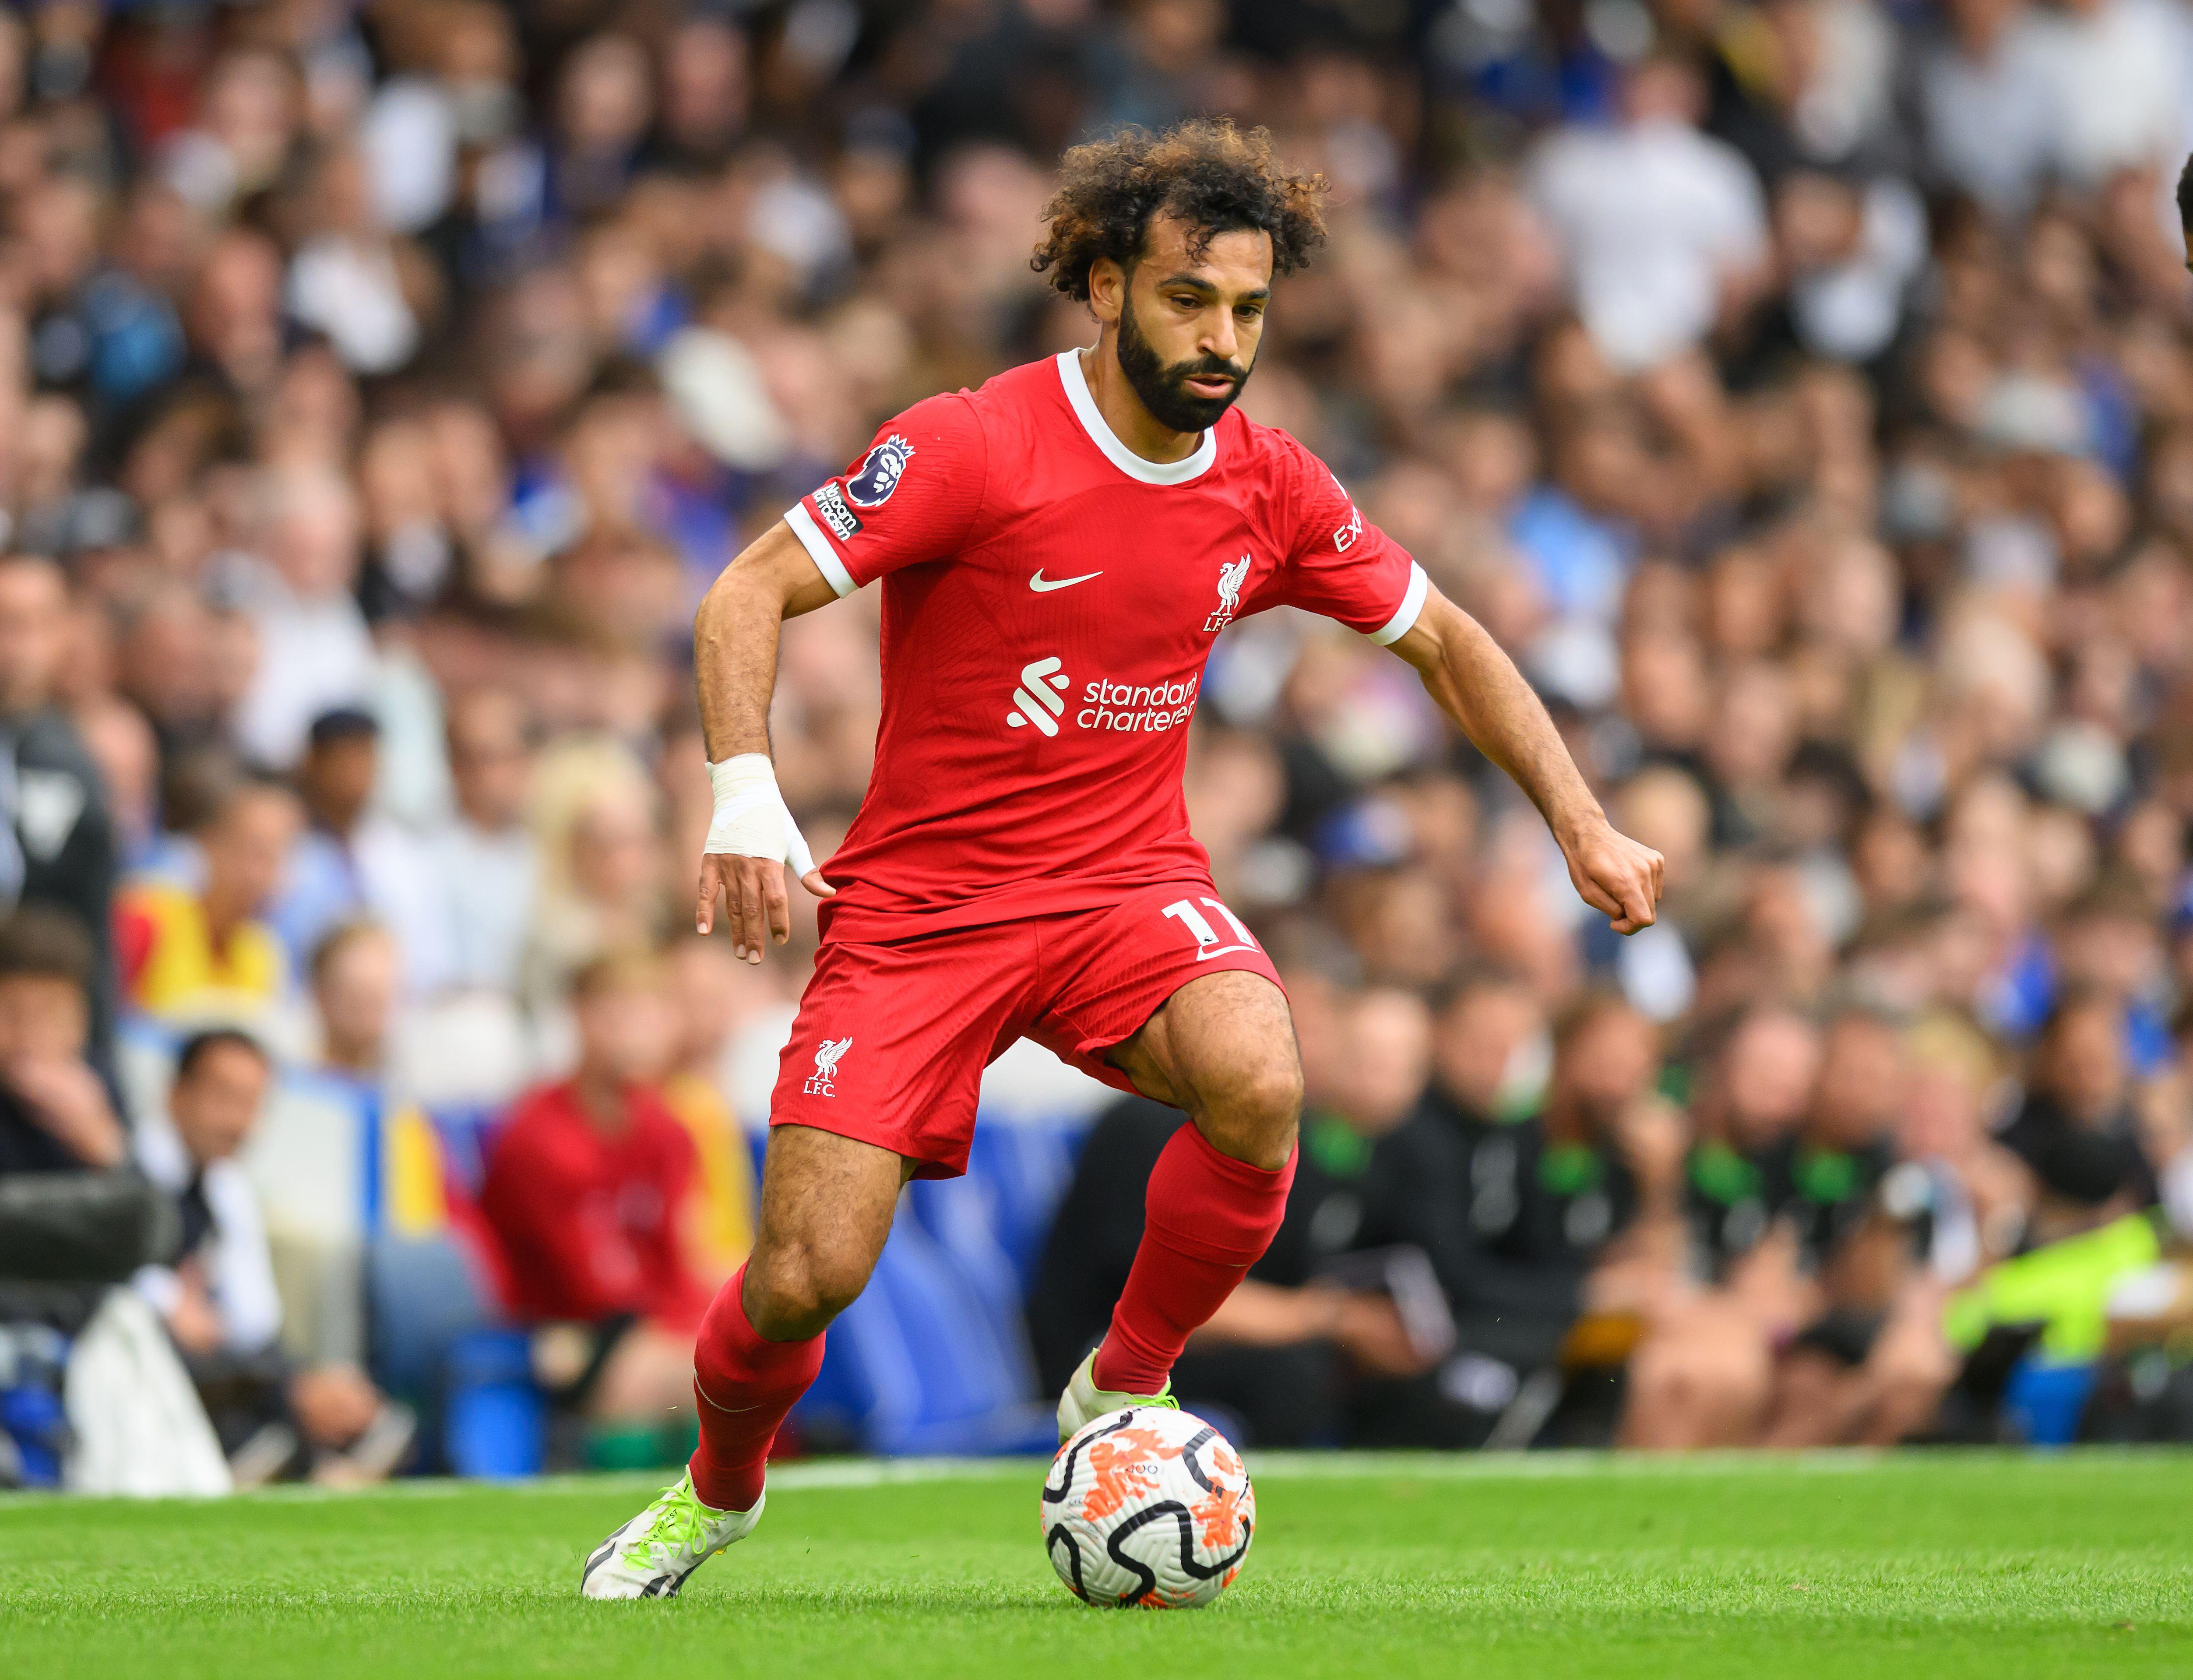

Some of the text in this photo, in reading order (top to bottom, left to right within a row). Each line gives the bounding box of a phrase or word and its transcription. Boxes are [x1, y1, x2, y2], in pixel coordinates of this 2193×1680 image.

[818, 500, 851, 541] racism
[828, 495, 857, 530] room
[1083, 672, 1197, 706] standard
[1077, 693, 1197, 733] chartered
[1161, 897, 1256, 947] 11
[803, 1081, 836, 1098] L.F.C.
